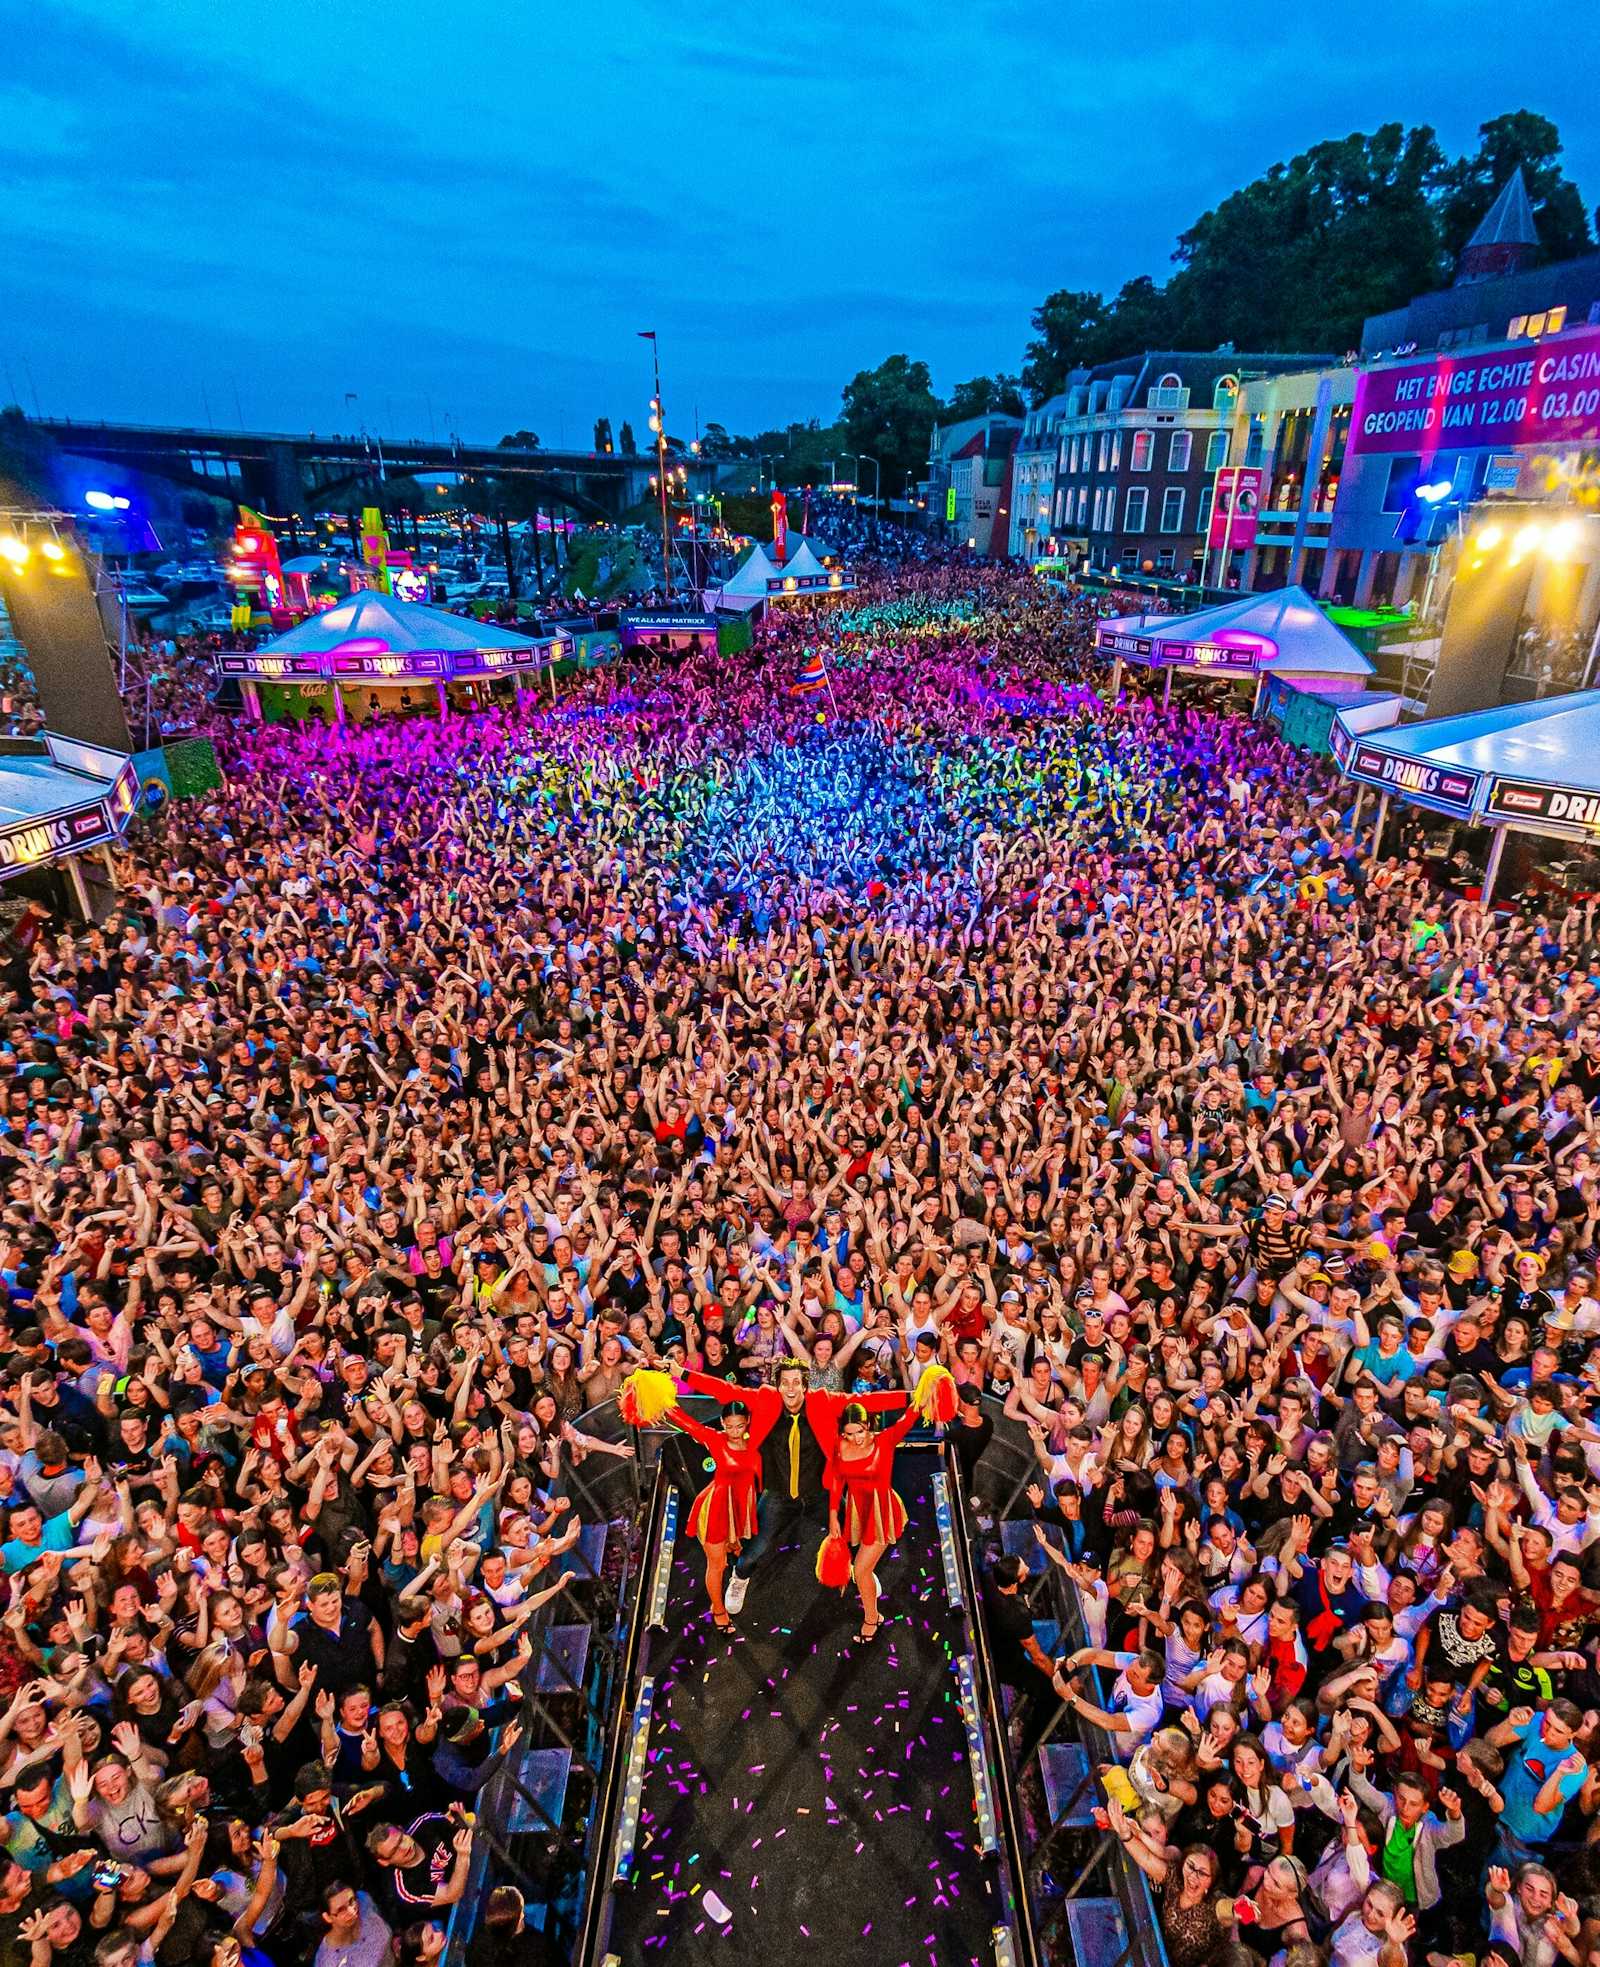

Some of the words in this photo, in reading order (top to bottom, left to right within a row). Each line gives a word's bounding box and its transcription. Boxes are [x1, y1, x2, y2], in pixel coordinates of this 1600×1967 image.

[1395, 375, 1425, 402] HET
[1425, 369, 1477, 398] ENIGE
[1478, 361, 1536, 393] ECHTE
[1364, 408, 1436, 435] GEOPEND
[1441, 402, 1476, 428] VAN
[1480, 398, 1528, 425] 12.00
[1541, 388, 1600, 420] 03.00
[1114, 636, 1139, 652] DRINKS
[1185, 647, 1229, 663] DRINKS
[247, 658, 293, 674] DRINKS
[363, 658, 413, 674] DRINKS
[478, 652, 514, 668] DRINKS
[1382, 758, 1440, 792] DRINKS
[0, 819, 72, 864] DRINKS
[119, 1801, 160, 1845] CK
